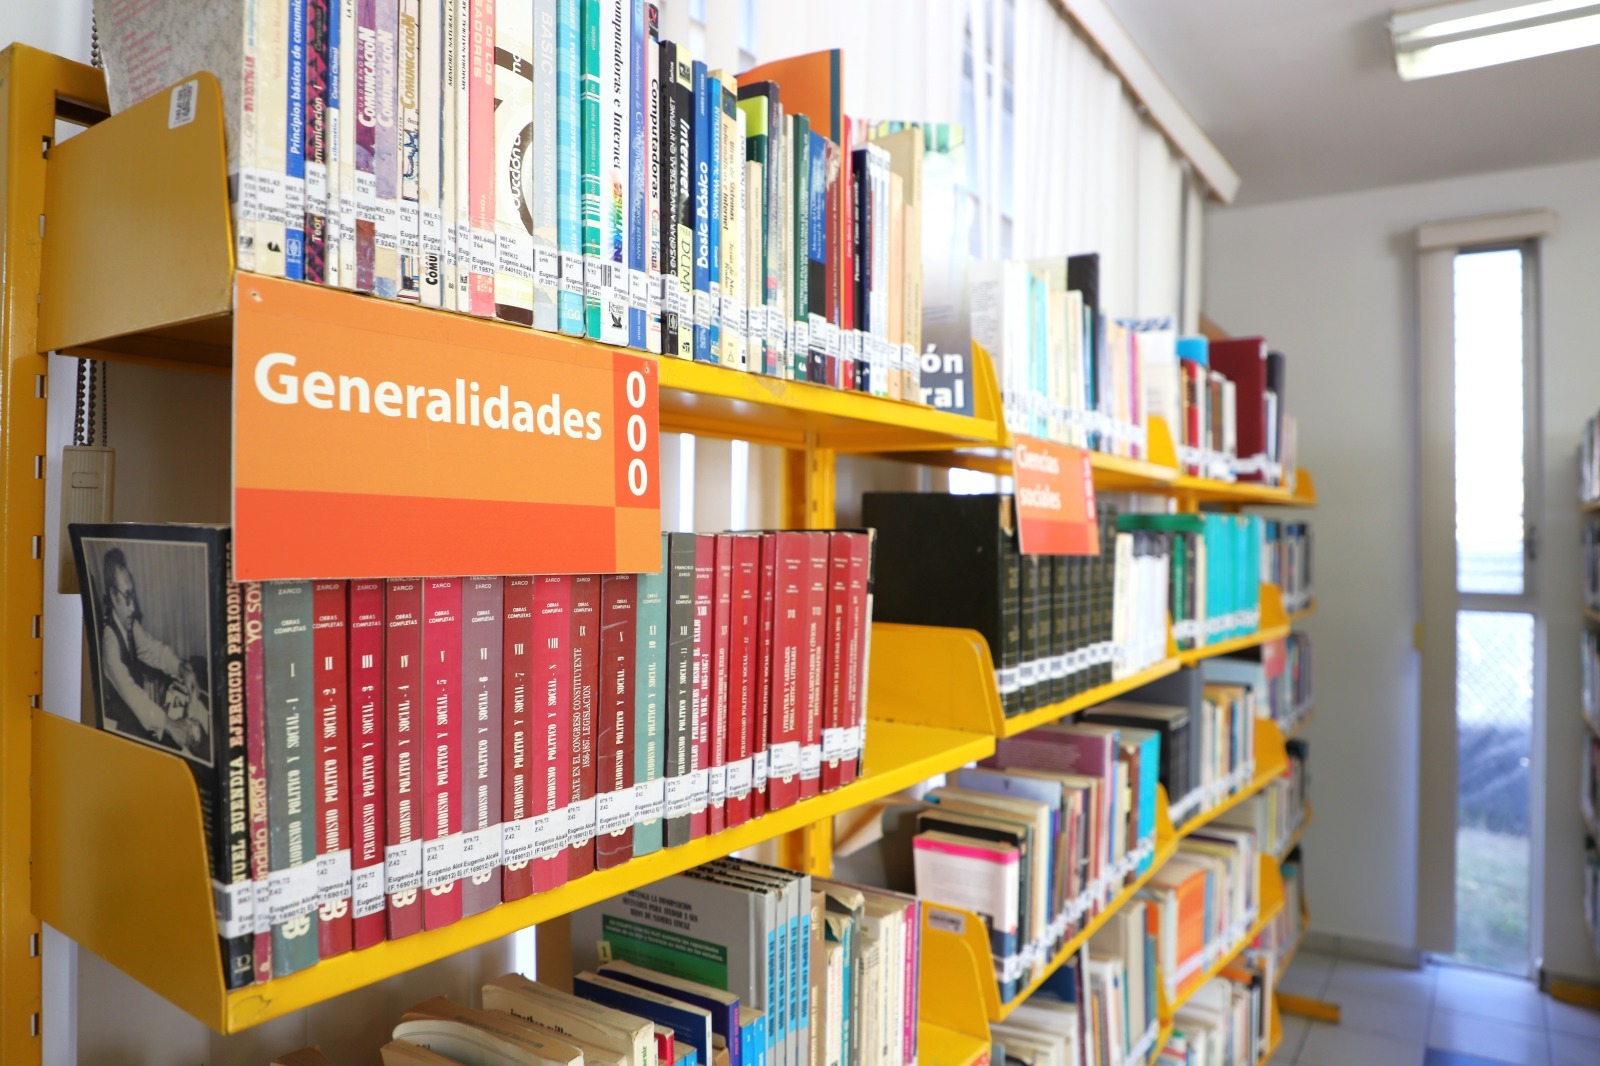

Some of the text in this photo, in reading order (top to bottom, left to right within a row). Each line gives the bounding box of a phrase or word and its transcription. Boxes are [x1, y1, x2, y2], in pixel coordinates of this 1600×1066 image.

[485, 26, 493, 86] DE LOS
[290, 0, 302, 155] Principios básicos de comunic
[541, 11, 554, 191] BASIC EL COMPUTADOR
[669, 97, 677, 140] INTERNET
[612, 111, 623, 170] Internet
[649, 78, 660, 199] Computadoras
[679, 118, 691, 199] Internet
[312, 96, 324, 242] Teor omunicación
[729, 180, 737, 222] Sistemas
[472, 256, 494, 267] Eugenio
[499, 257, 519, 268] Eugenio
[539, 270, 558, 280] Eugenio
[565, 276, 583, 286] Eugenio
[566, 308, 581, 321] GG
[254, 351, 602, 441] Generalidades
[1016, 444, 1060, 475] Ciencias
[1019, 483, 1062, 511] sociales
[245, 619, 262, 645] YO
[693, 619, 701, 643] EXILIO
[692, 661, 700, 684] DESDE
[398, 700, 410, 732] SOCIAL
[436, 693, 448, 726] SOCIAL
[572, 647, 582, 774] EN EL CONGRESO CONSTITUYENTE
[582, 685, 591, 735] LEGISLACION
[616, 668, 625, 745] POLITICO SOCIAL
[647, 662, 657, 737] POLITICO SOCIAL
[678, 659, 687, 732] POLITICO SOCIAL
[286, 712, 300, 749] SOCIAL
[323, 704, 337, 739] SOCIAL
[361, 701, 374, 735] SOCIAL
[478, 690, 489, 780] POLITICO SOCIAL
[513, 684, 525, 770] POLITICO SOCIAL
[547, 678, 557, 761] POLITICO SOCIAL
[699, 721, 708, 743] NUEVA
[228, 661, 246, 835] BUENDIA EJERCICIO
[436, 744, 448, 786] POLITICO
[287, 769, 302, 816] POLITICO
[324, 759, 338, 803] POLITICO
[362, 755, 375, 798] POLITICO
[398, 751, 411, 794] POLITICO
[363, 803, 375, 861] PERIODISMO
[504, 845, 527, 857] Eugenio
[534, 837, 556, 848] Eugenio
[387, 871, 414, 884] Eugenio
[426, 866, 452, 879] Eugenio
[463, 858, 482, 870] Eugenio
[356, 895, 380, 908] Eugenio
